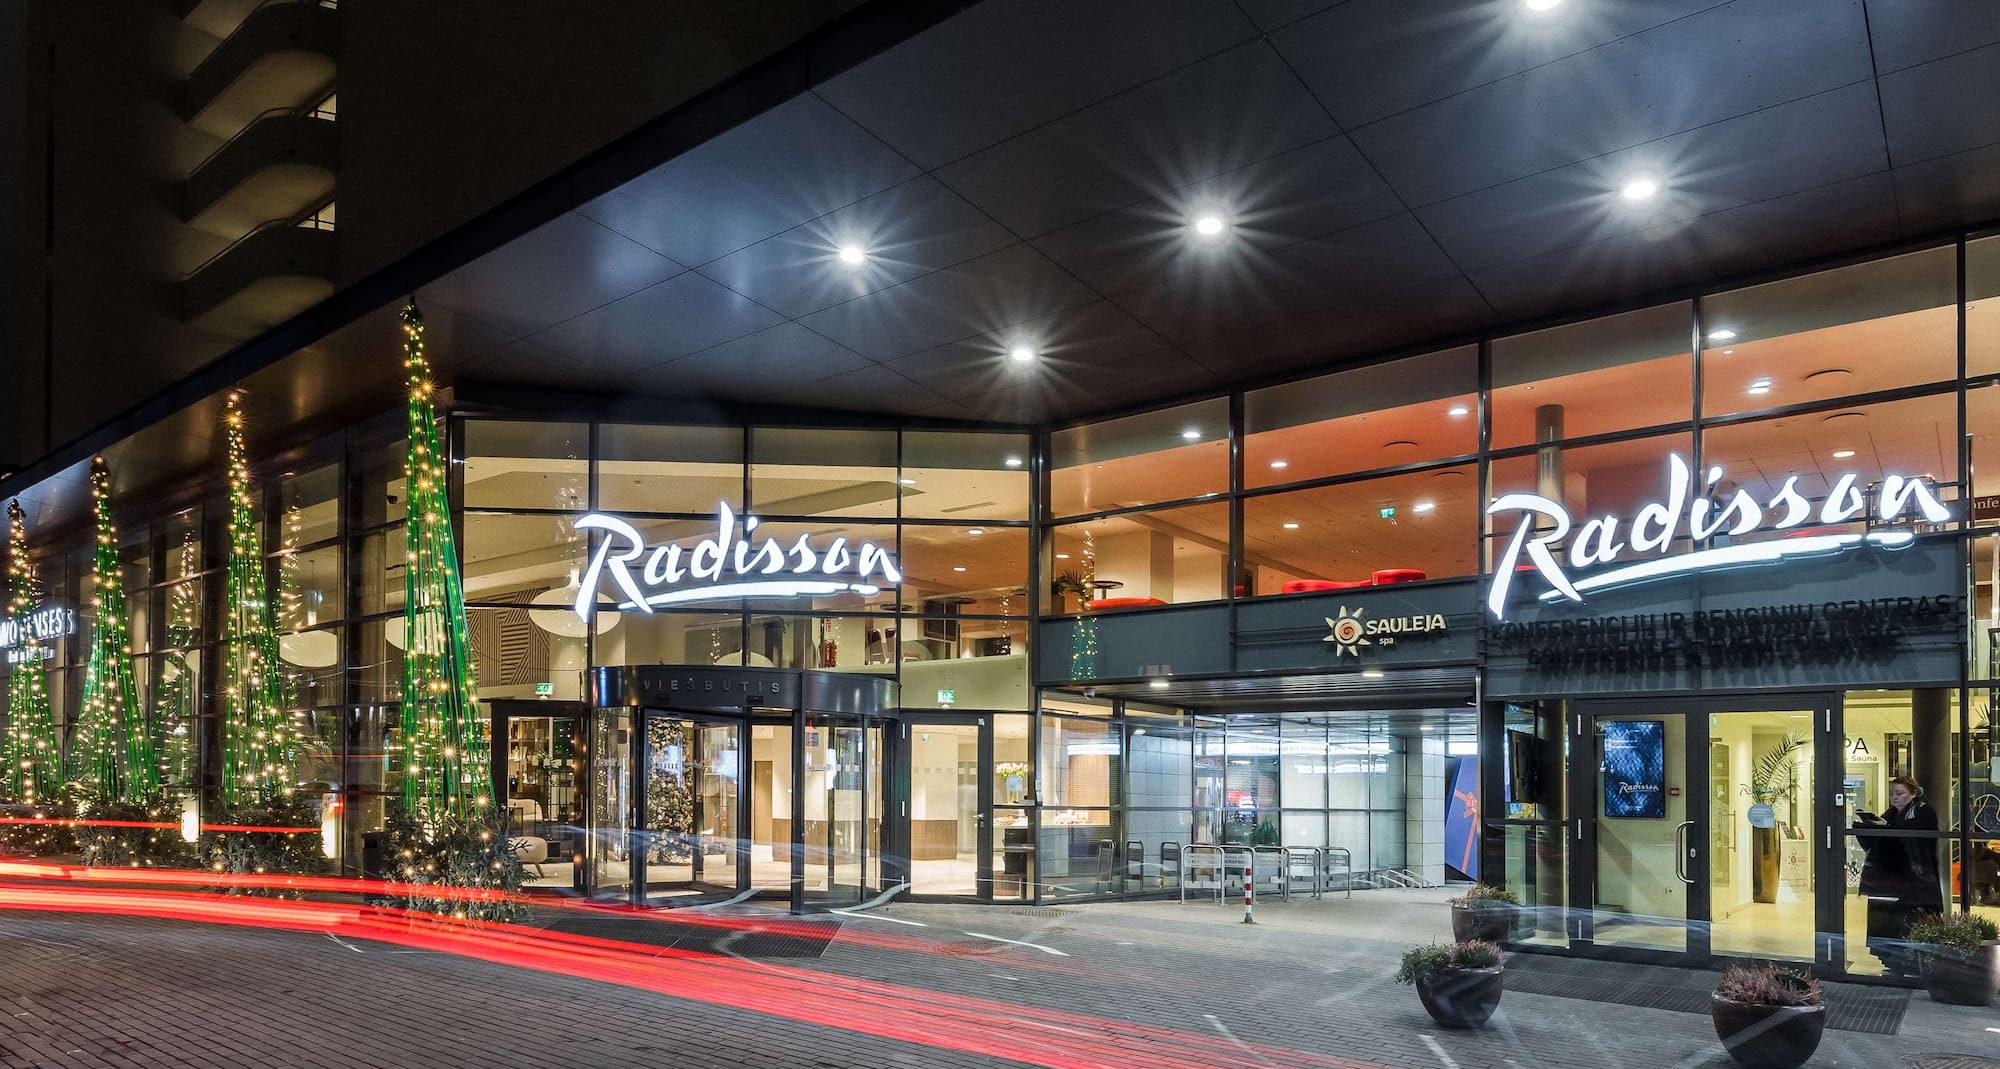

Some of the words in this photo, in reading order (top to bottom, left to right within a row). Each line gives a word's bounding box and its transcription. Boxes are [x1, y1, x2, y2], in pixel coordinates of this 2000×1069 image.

[1486, 453, 1950, 621] Radisson
[573, 500, 902, 623] Radisson
[1366, 614, 1447, 635] SAULEJA
[1378, 636, 1394, 646] spa
[643, 678, 780, 693] VIEŠBUTIS
